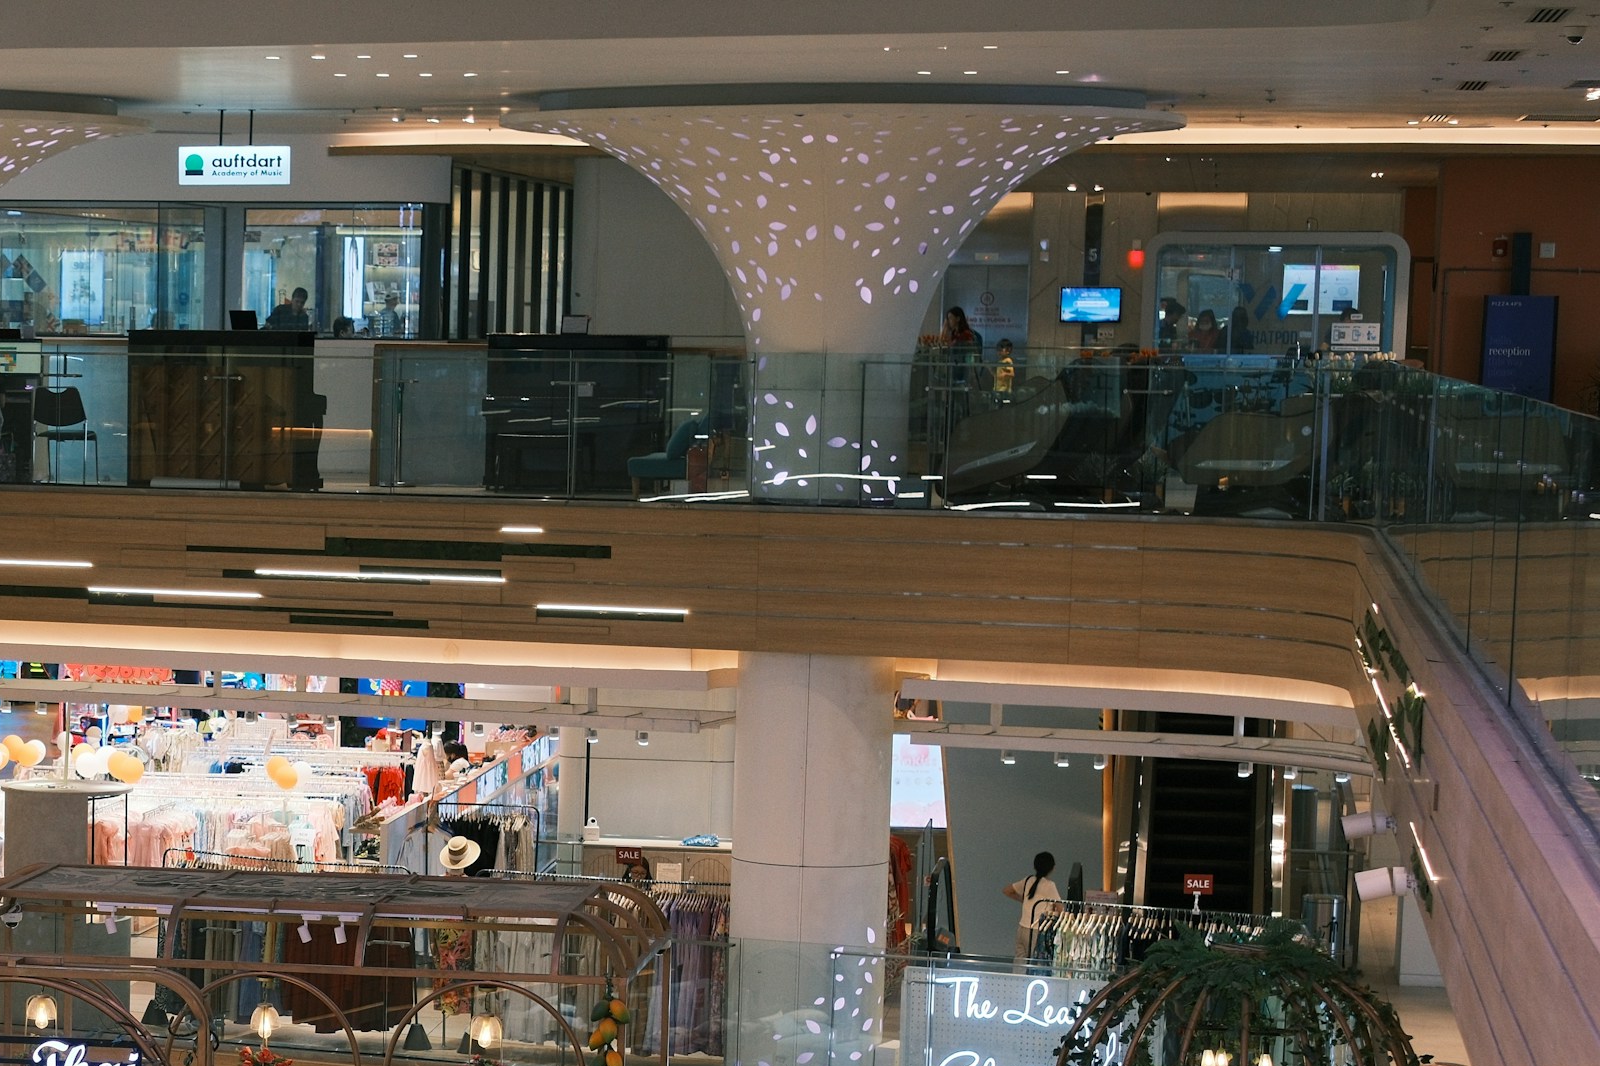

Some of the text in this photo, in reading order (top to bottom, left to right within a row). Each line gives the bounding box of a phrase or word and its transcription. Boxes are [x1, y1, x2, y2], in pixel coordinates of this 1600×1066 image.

[212, 154, 282, 167] auftdart
[1089, 248, 1098, 262] 5
[1245, 330, 1298, 345] HATPOD
[1489, 346, 1531, 357] reception
[618, 850, 640, 859] SALE
[1187, 879, 1210, 889] SALE
[935, 976, 998, 1019] The
